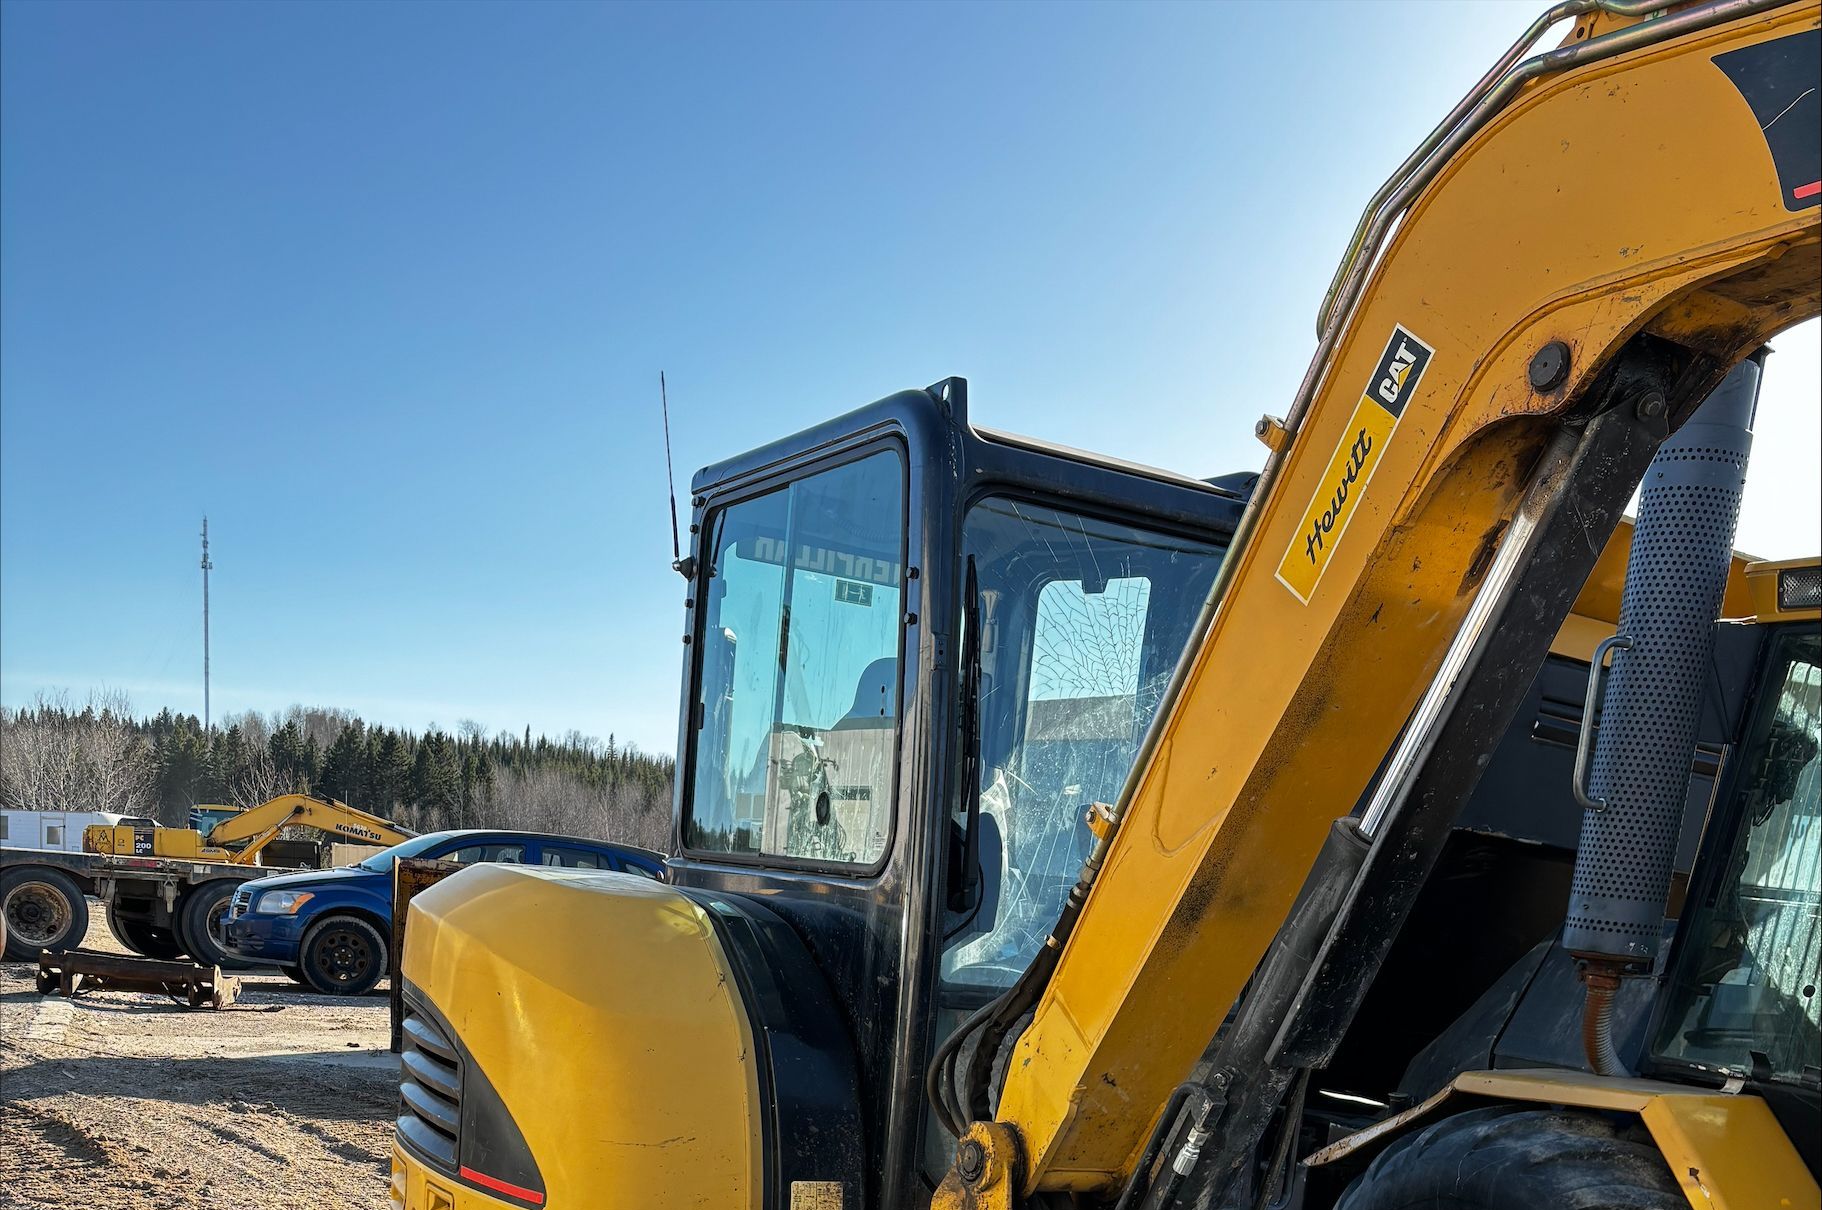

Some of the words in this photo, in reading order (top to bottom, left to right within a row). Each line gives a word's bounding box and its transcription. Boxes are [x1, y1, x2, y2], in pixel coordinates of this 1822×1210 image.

[1378, 340, 1417, 404] CAT
[1305, 427, 1373, 565] Hewitt
[335, 823, 382, 841] KOMATSU
